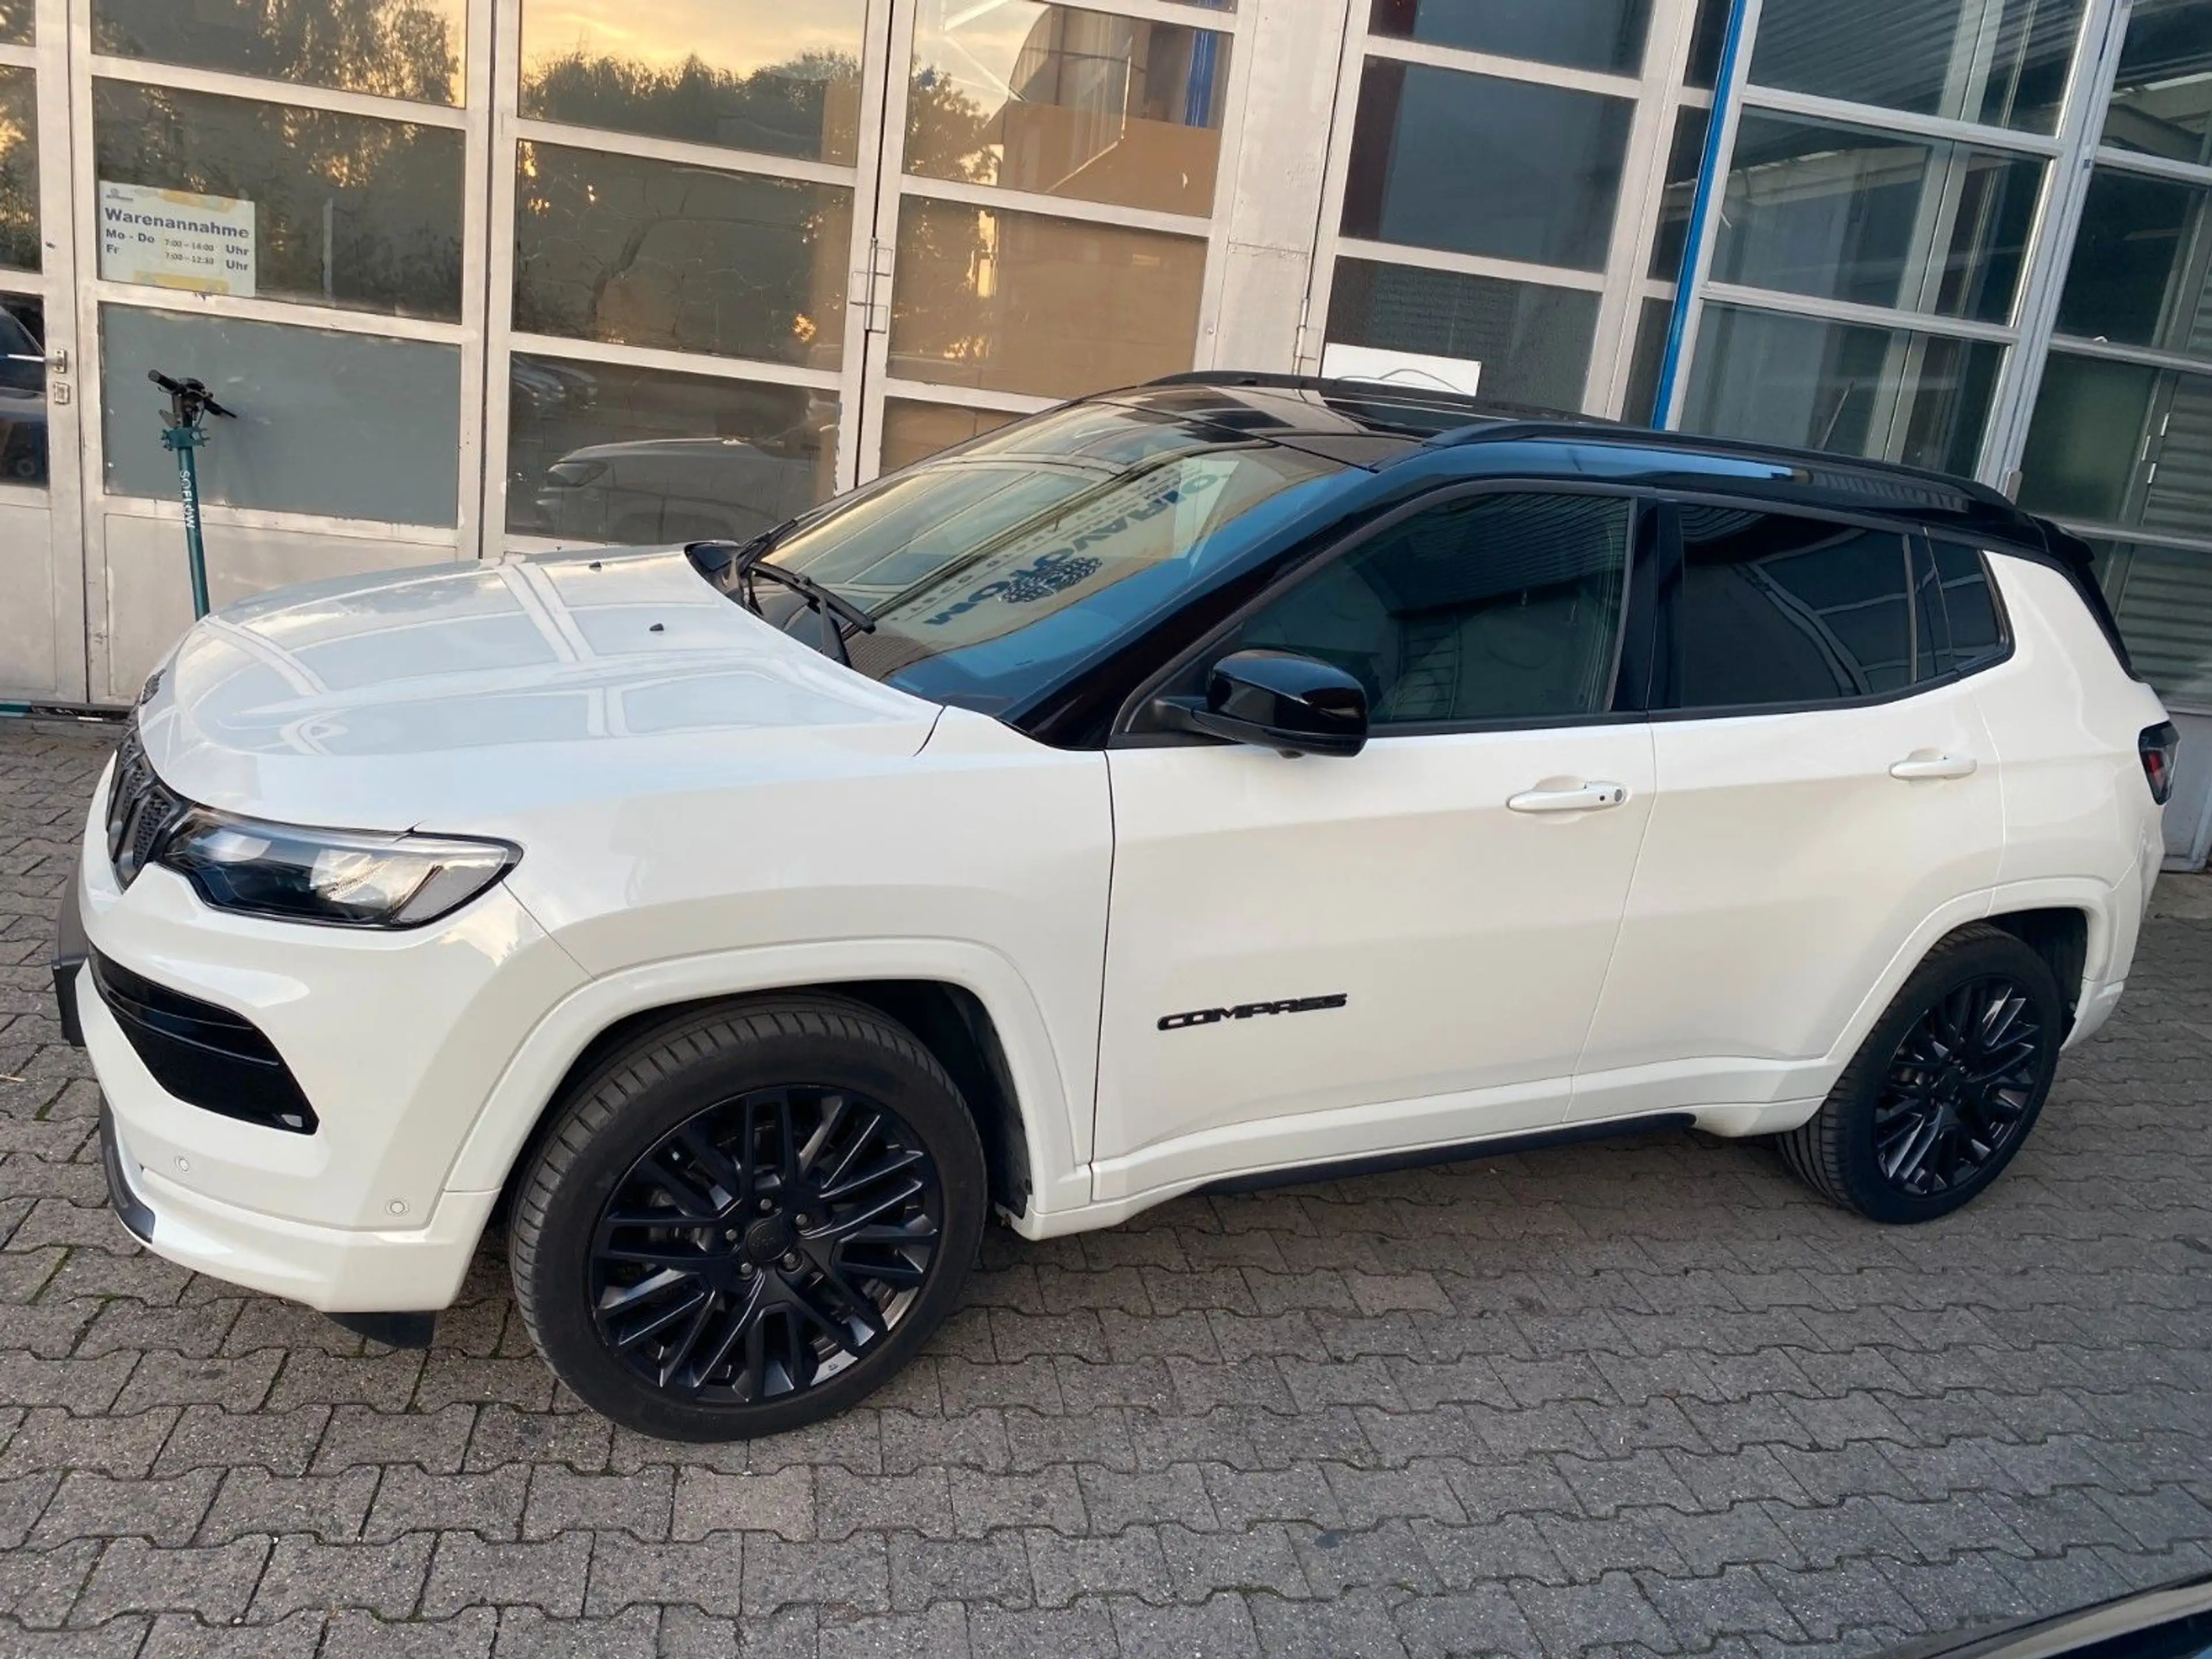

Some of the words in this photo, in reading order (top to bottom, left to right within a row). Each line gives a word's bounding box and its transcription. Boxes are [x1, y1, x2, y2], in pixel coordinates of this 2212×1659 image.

[105, 207, 249, 238] Warenannahme
[106, 229, 125, 239] Mo
[138, 233, 154, 243] Do
[226, 244, 249, 256] Uhr
[106, 244, 118, 253] Fr
[226, 260, 249, 270] Uhr
[180, 470, 195, 528] SOFLOW
[1157, 993, 1347, 1031] COMPASS
